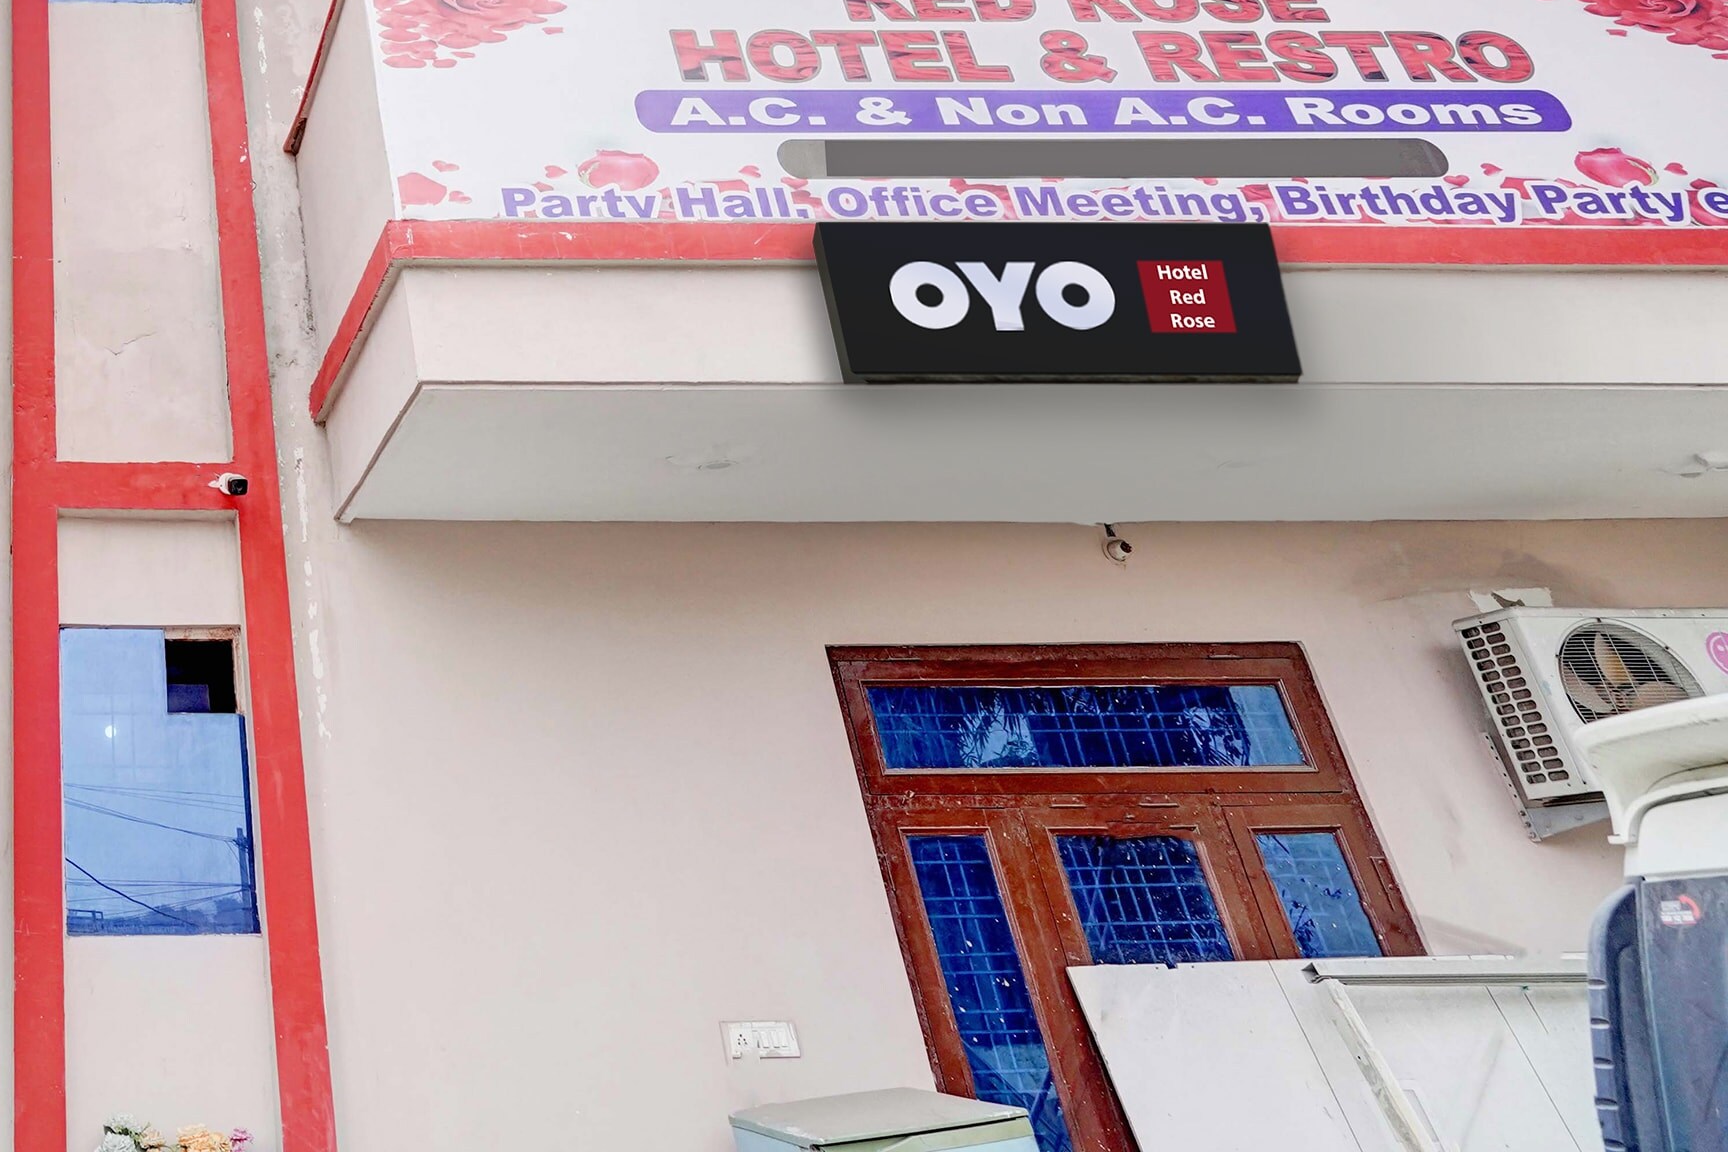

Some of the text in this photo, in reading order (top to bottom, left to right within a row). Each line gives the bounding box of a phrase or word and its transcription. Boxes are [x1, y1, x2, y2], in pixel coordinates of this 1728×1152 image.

[669, 29, 1535, 84] HOTEL & RESTRO
[671, 97, 1542, 127] A.C. & Non A.C. Rooms
[501, 187, 656, 219] Party
[827, 186, 998, 217] Office
[1014, 186, 1263, 223] Meeting,
[1276, 185, 1514, 223] Birthday
[1530, 184, 1684, 222] Party
[1157, 264, 1209, 280] Hotel
[889, 260, 1116, 332] OYO
[1170, 289, 1206, 305] Red
[1171, 313, 1215, 329] Rose
